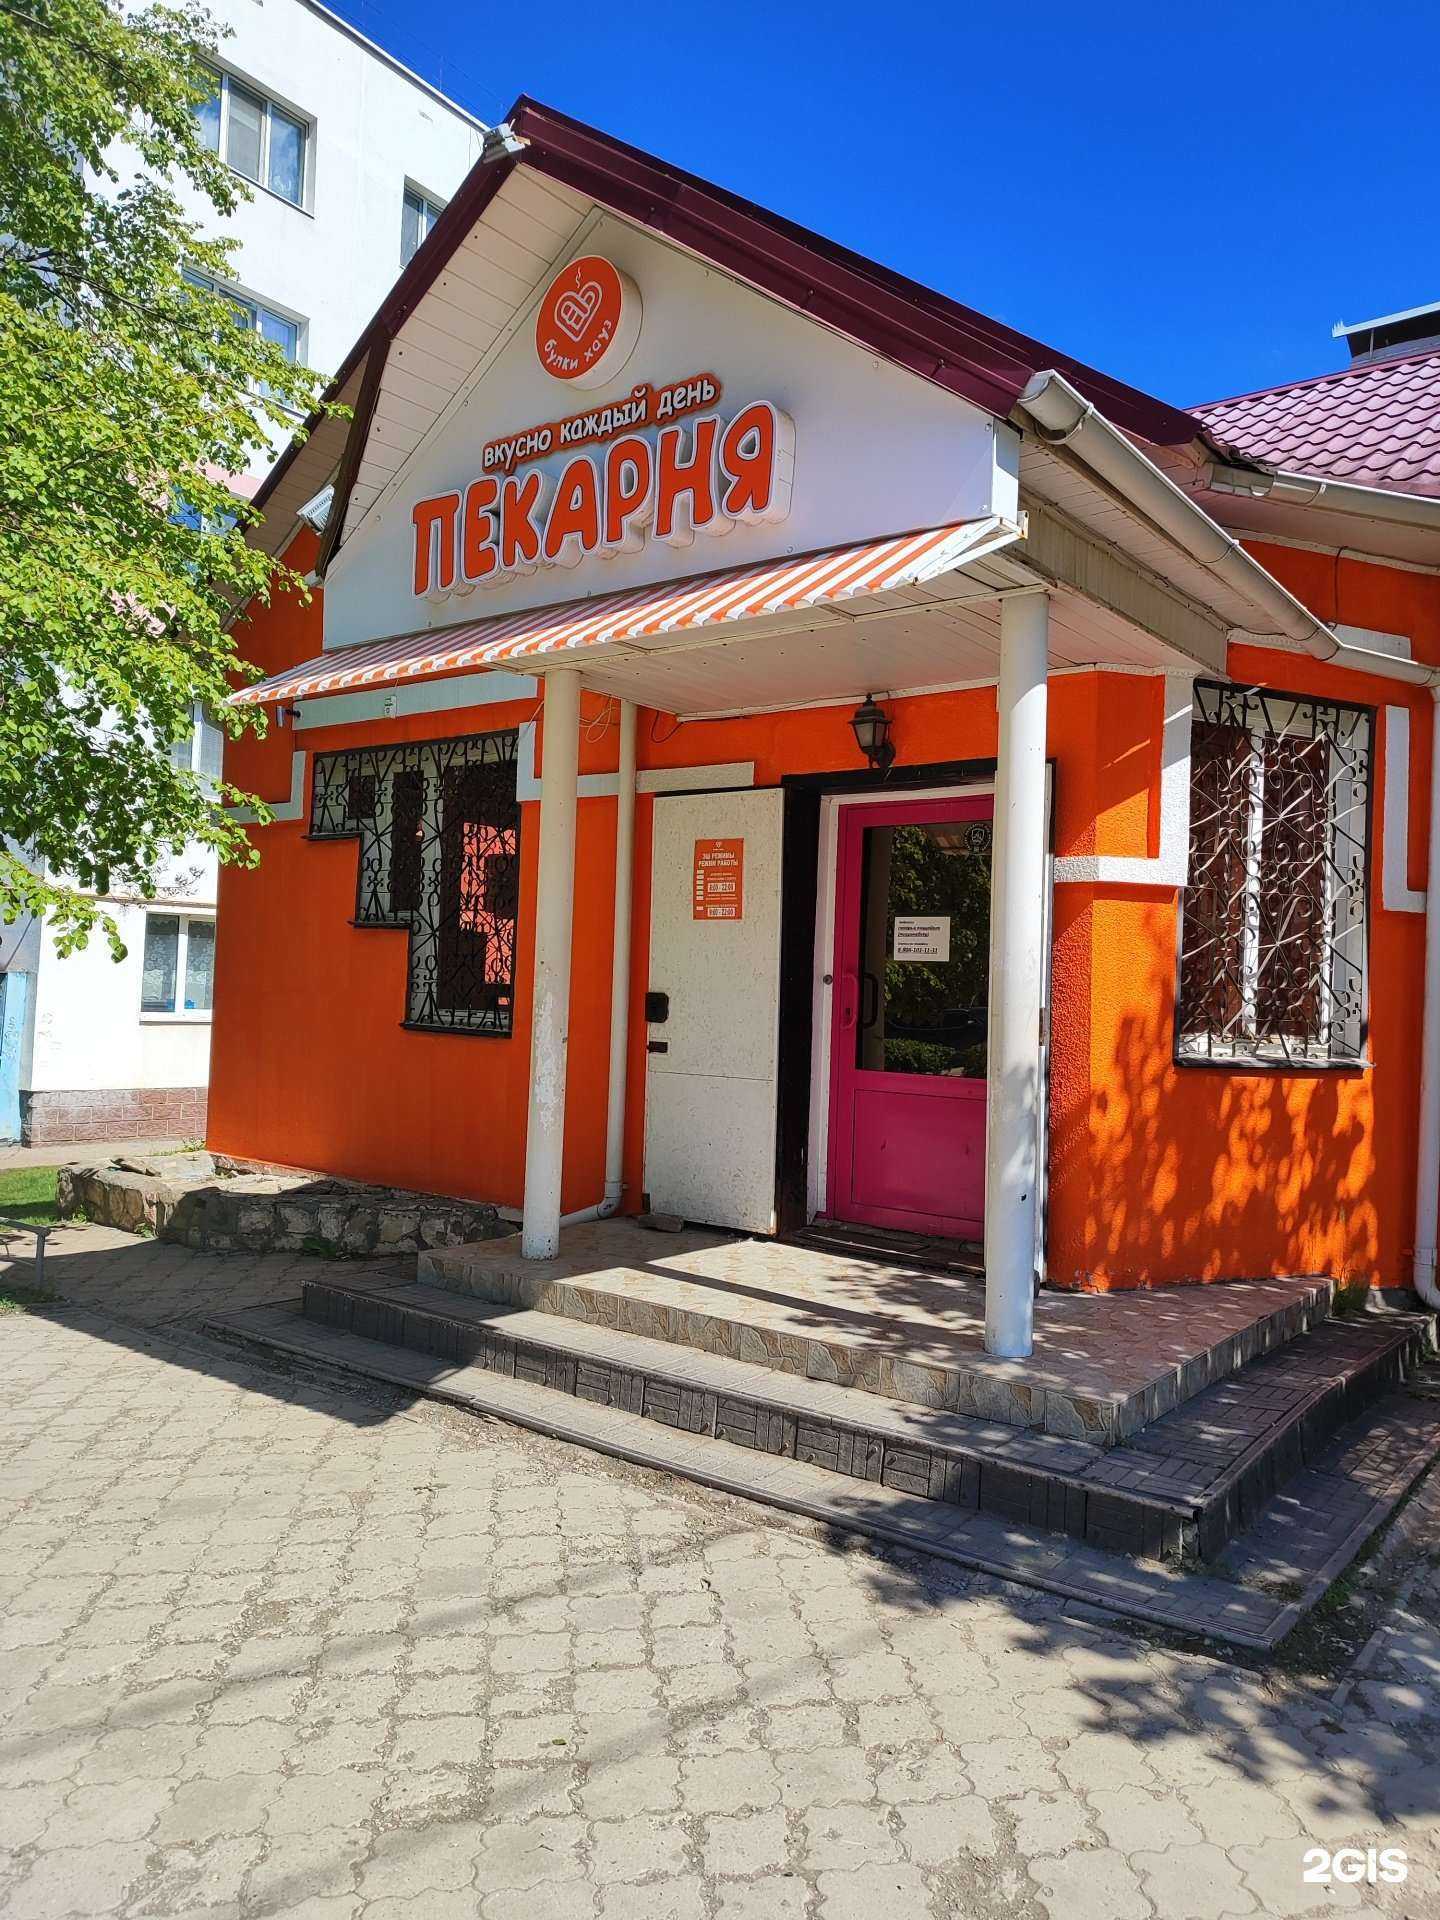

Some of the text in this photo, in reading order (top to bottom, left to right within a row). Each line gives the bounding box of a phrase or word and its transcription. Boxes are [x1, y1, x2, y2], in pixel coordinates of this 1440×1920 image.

[544, 319, 612, 371] булки хауз
[483, 377, 716, 470] вкусно каждый день
[412, 401, 776, 597] ПЕКАРНЯ
